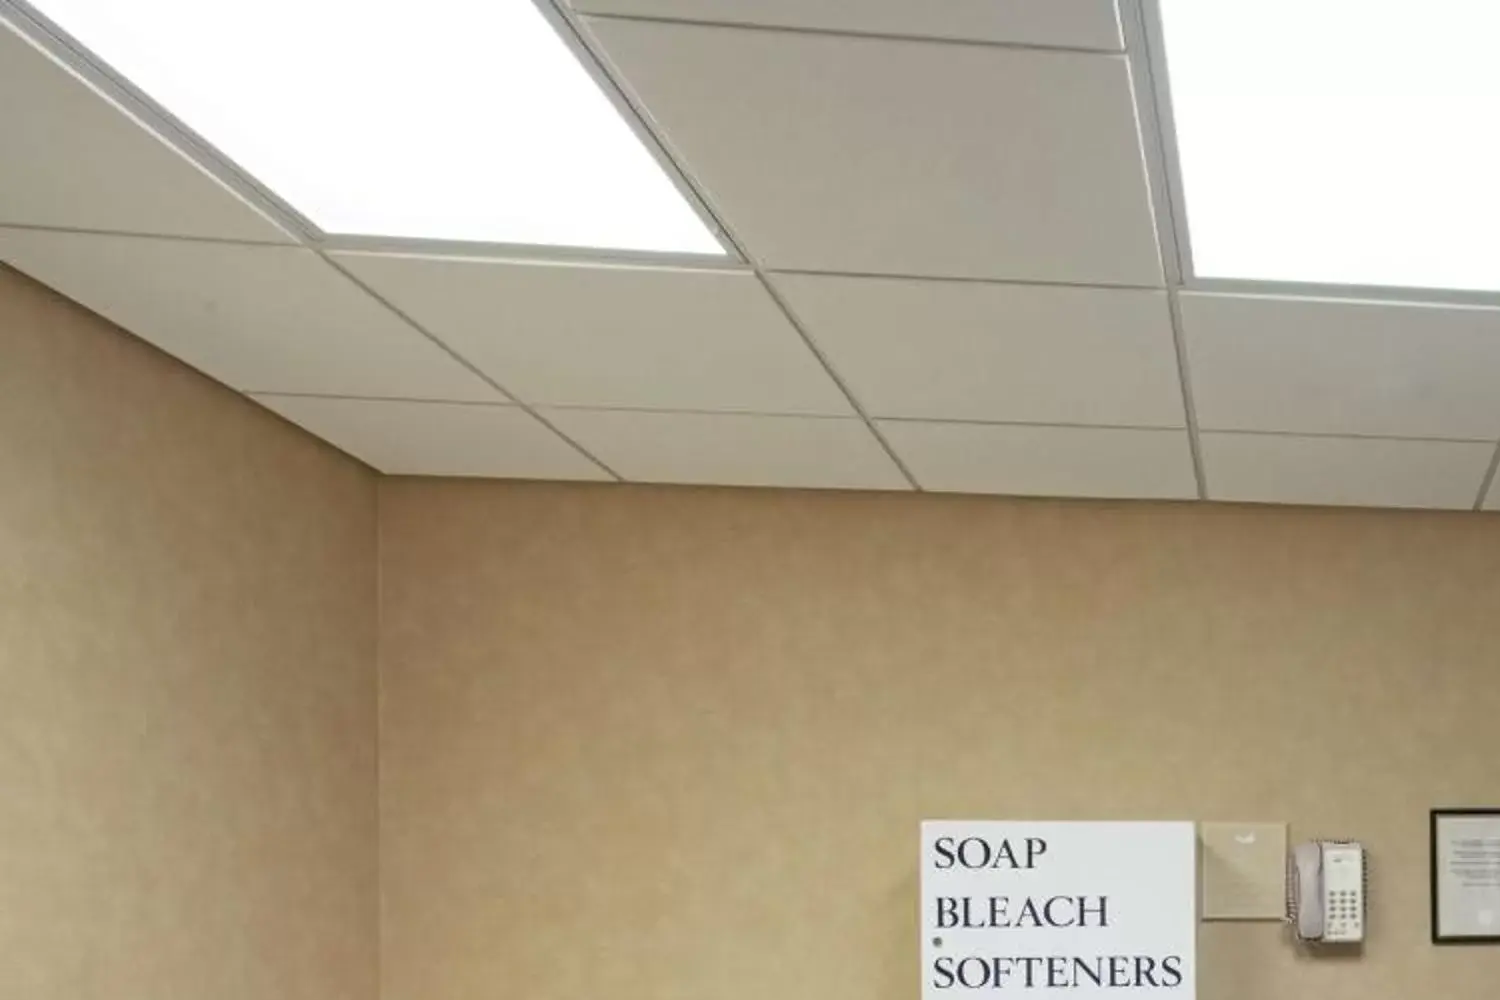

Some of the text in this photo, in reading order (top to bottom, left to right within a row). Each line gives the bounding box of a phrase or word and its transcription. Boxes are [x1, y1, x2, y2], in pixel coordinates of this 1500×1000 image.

[934, 837, 1047, 869] SOAP
[936, 896, 1107, 928] BLEACH
[933, 956, 1183, 989] SOFTENERS
